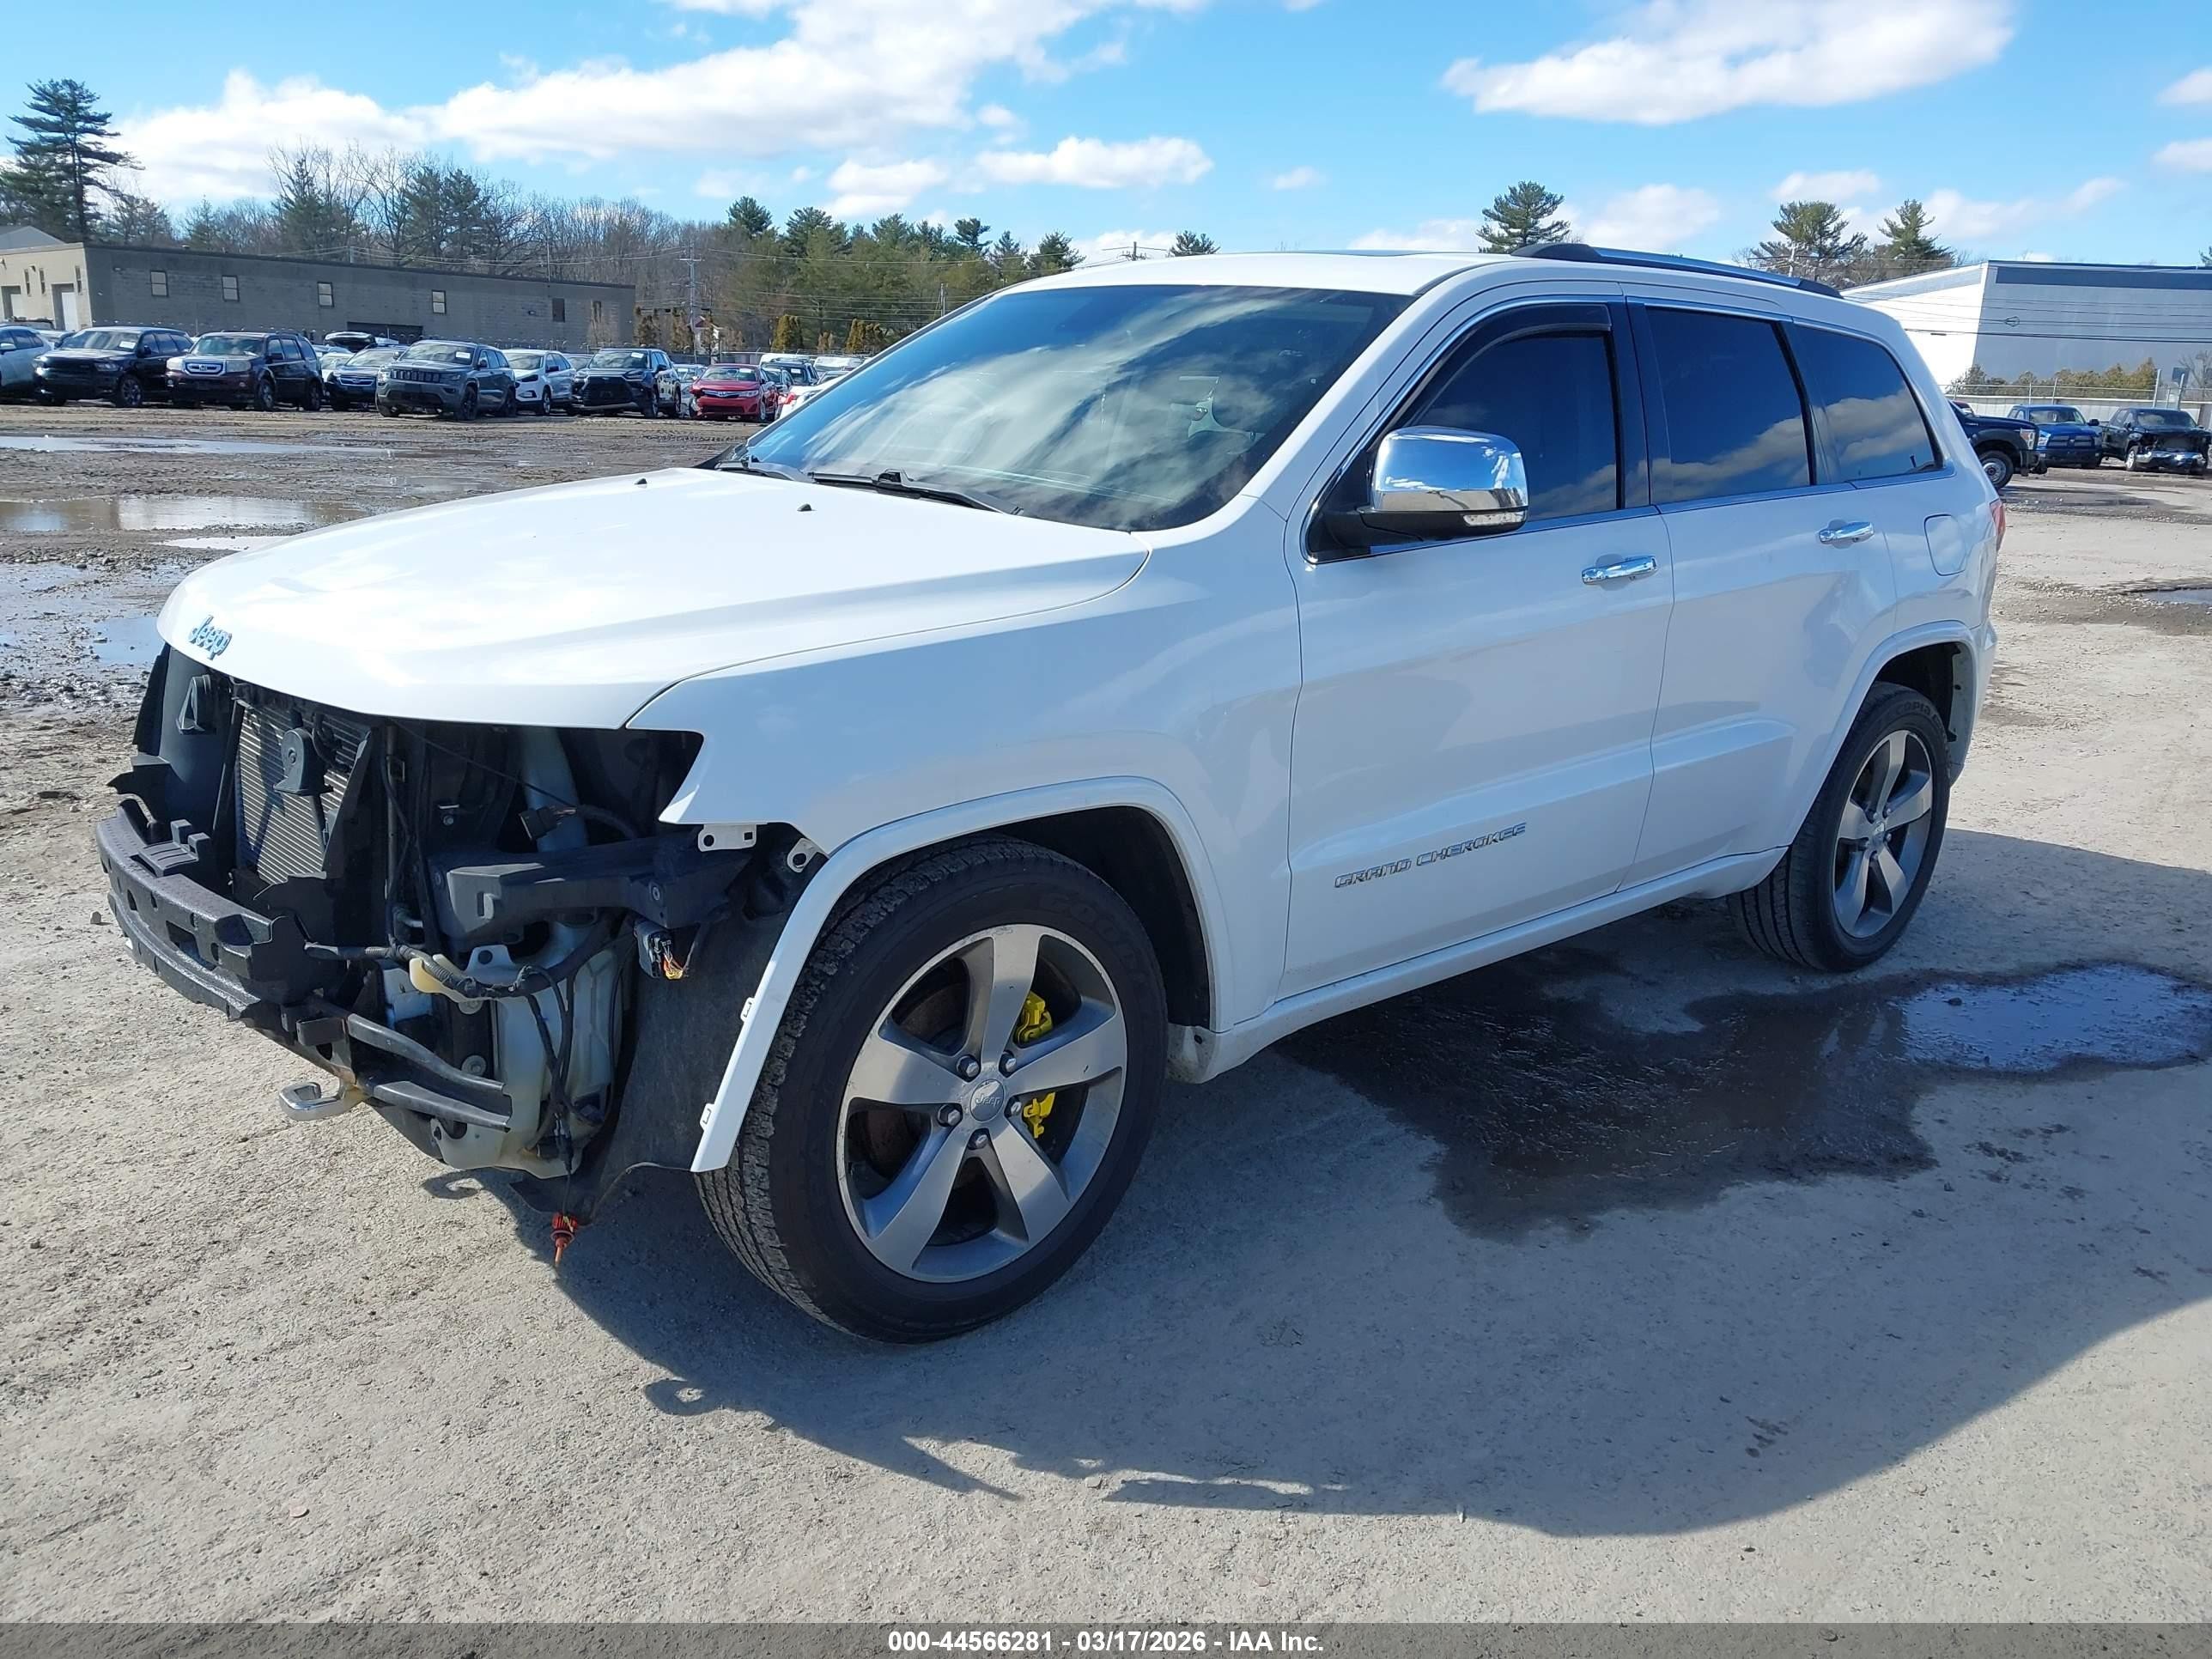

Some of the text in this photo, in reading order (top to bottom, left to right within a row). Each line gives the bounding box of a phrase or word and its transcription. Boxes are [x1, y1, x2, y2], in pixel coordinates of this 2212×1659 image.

[188, 614, 232, 661] Jeep
[1334, 822, 1527, 888] GRAND CHEROKEE
